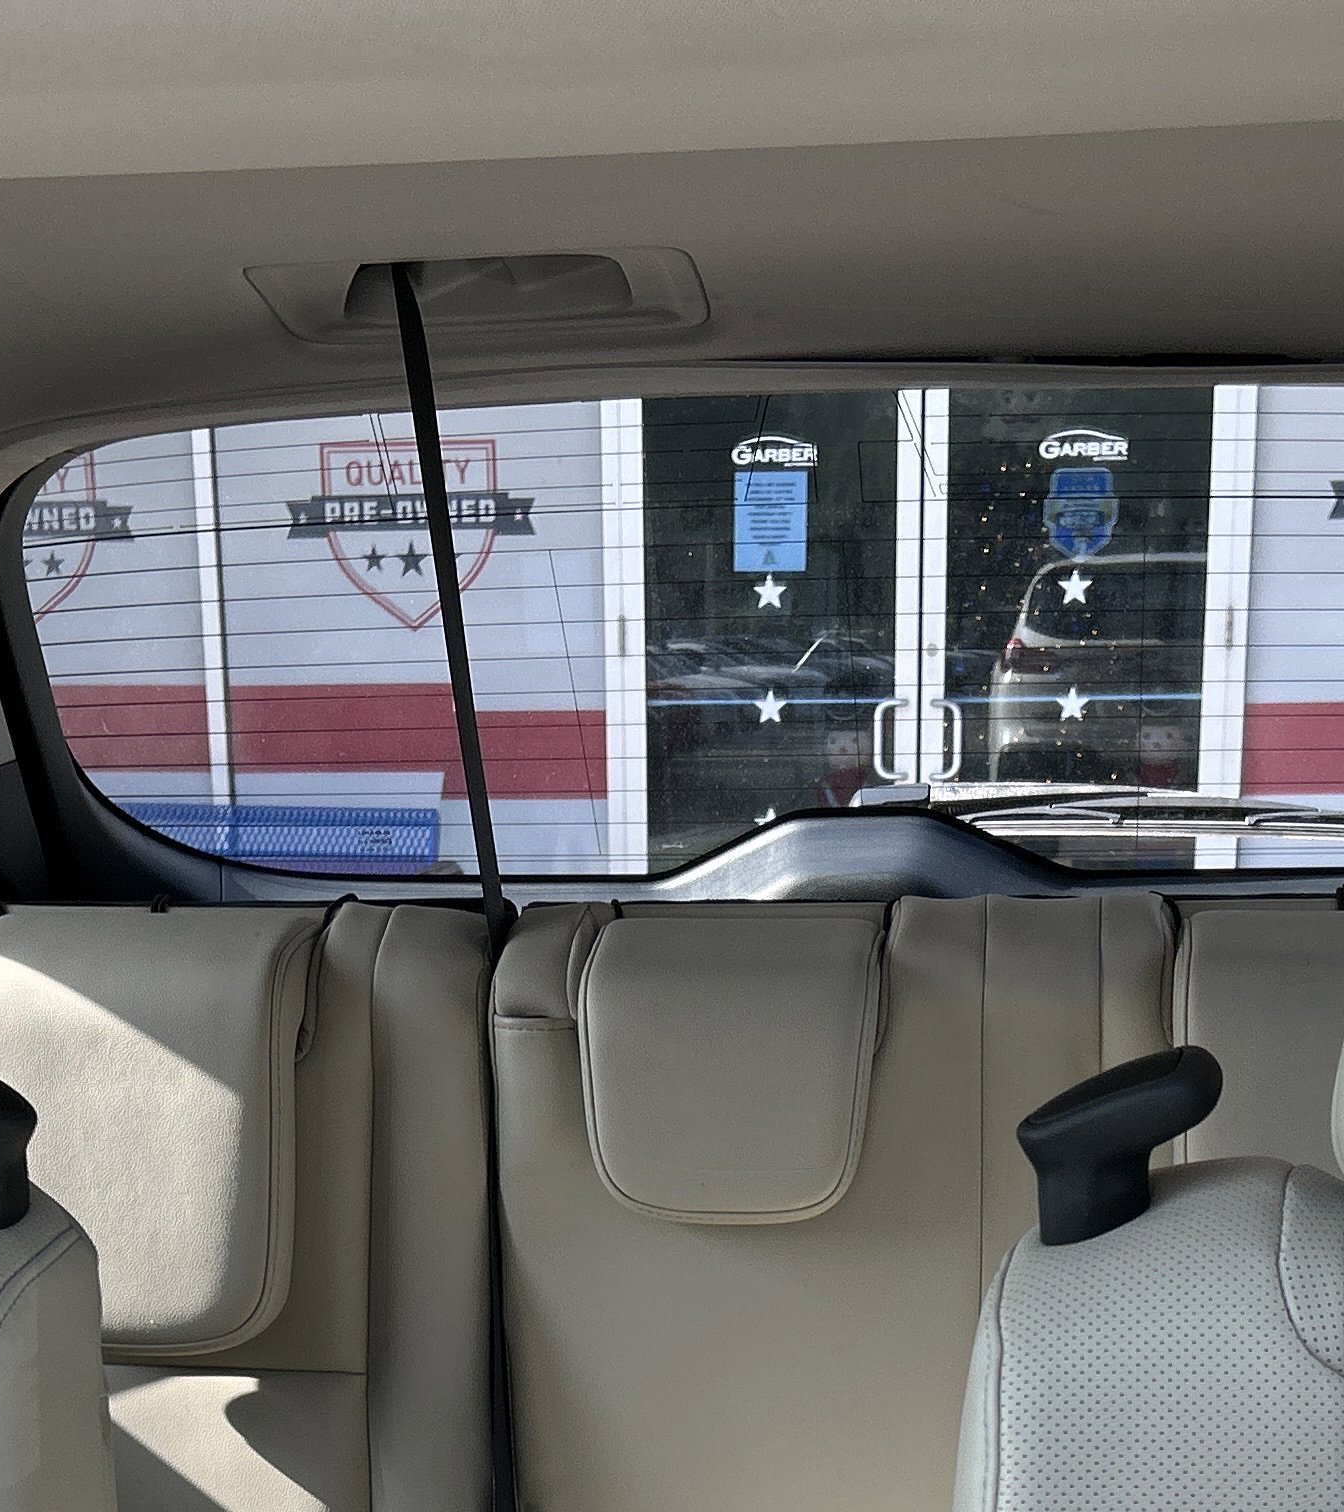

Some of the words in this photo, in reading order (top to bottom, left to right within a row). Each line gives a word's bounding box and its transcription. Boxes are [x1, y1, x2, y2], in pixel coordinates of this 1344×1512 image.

[731, 446, 818, 465] GARBER
[1039, 441, 1128, 459] GARBER
[344, 458, 470, 486] QUALTY
[324, 498, 496, 525] PRE-OED
